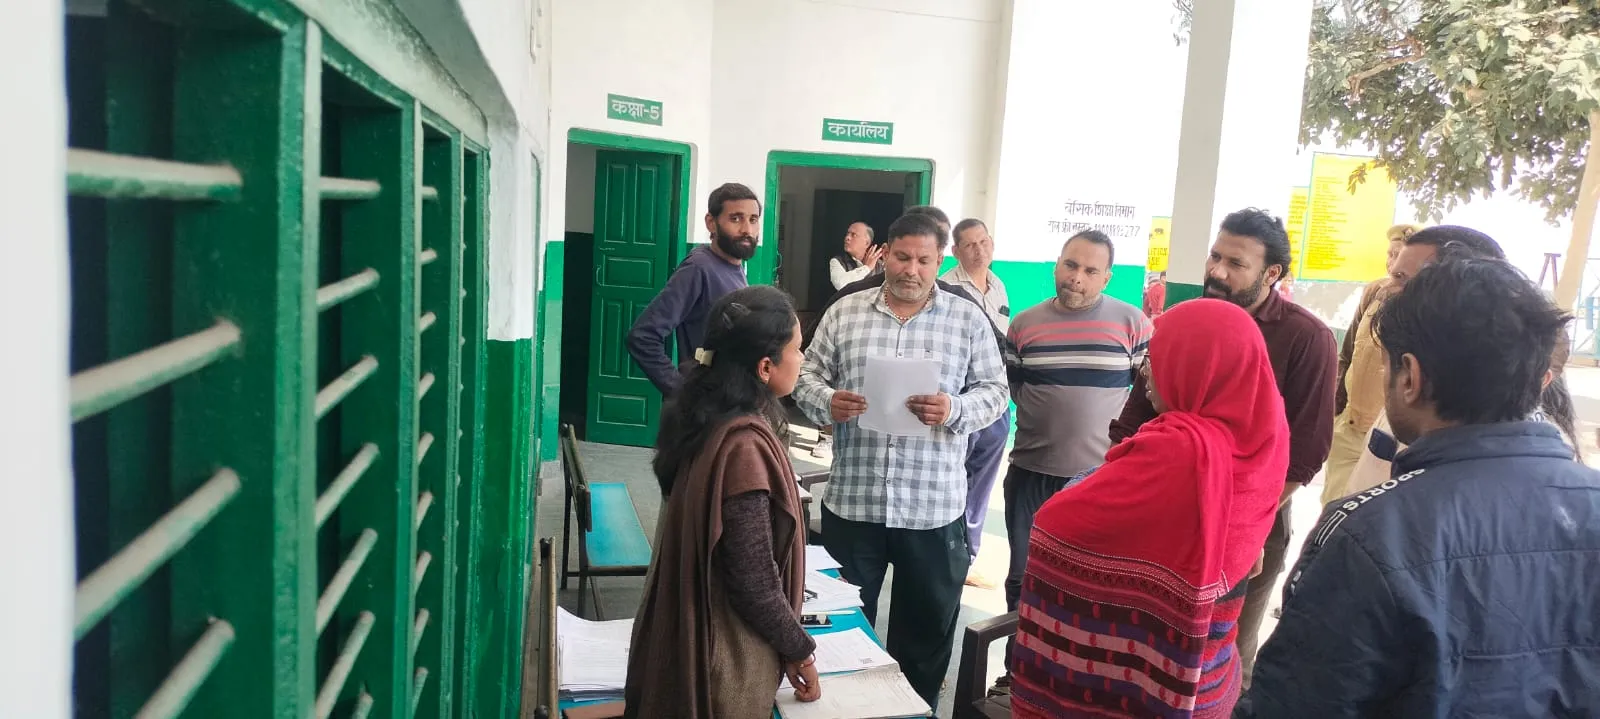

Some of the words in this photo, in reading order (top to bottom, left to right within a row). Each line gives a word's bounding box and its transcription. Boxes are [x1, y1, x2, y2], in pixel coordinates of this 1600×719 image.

[611, 99, 660, 120] कक्षा-5
[827, 121, 889, 140] कार्यालय
[1342, 468, 1426, 511] SPORTS
